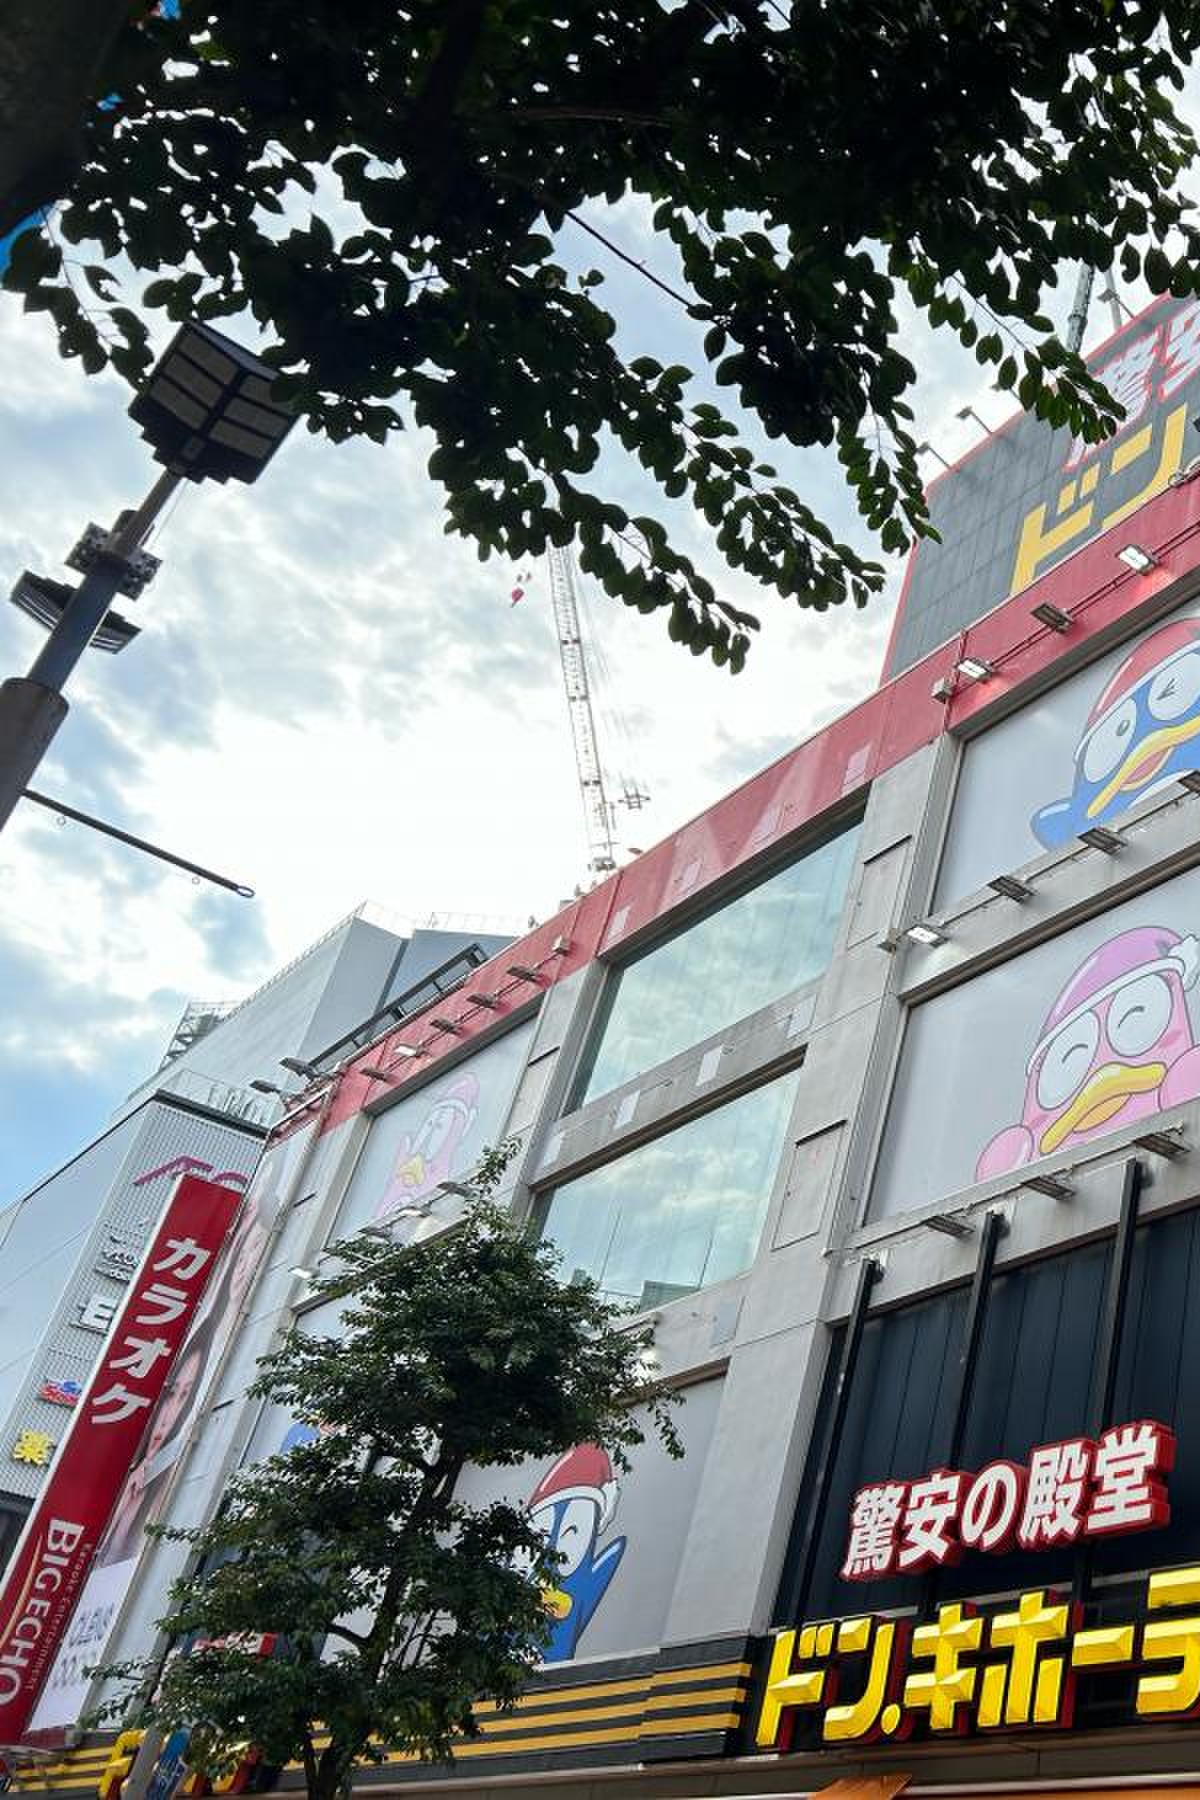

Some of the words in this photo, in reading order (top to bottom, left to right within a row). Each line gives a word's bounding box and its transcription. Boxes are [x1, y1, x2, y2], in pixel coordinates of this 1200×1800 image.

[91, 1236, 211, 1426] カラオケ
[35, 1519, 85, 1594] BIG
[842, 1421, 1168, 1580] 驚安の殿堂
[0, 1598, 52, 1706] ECHO
